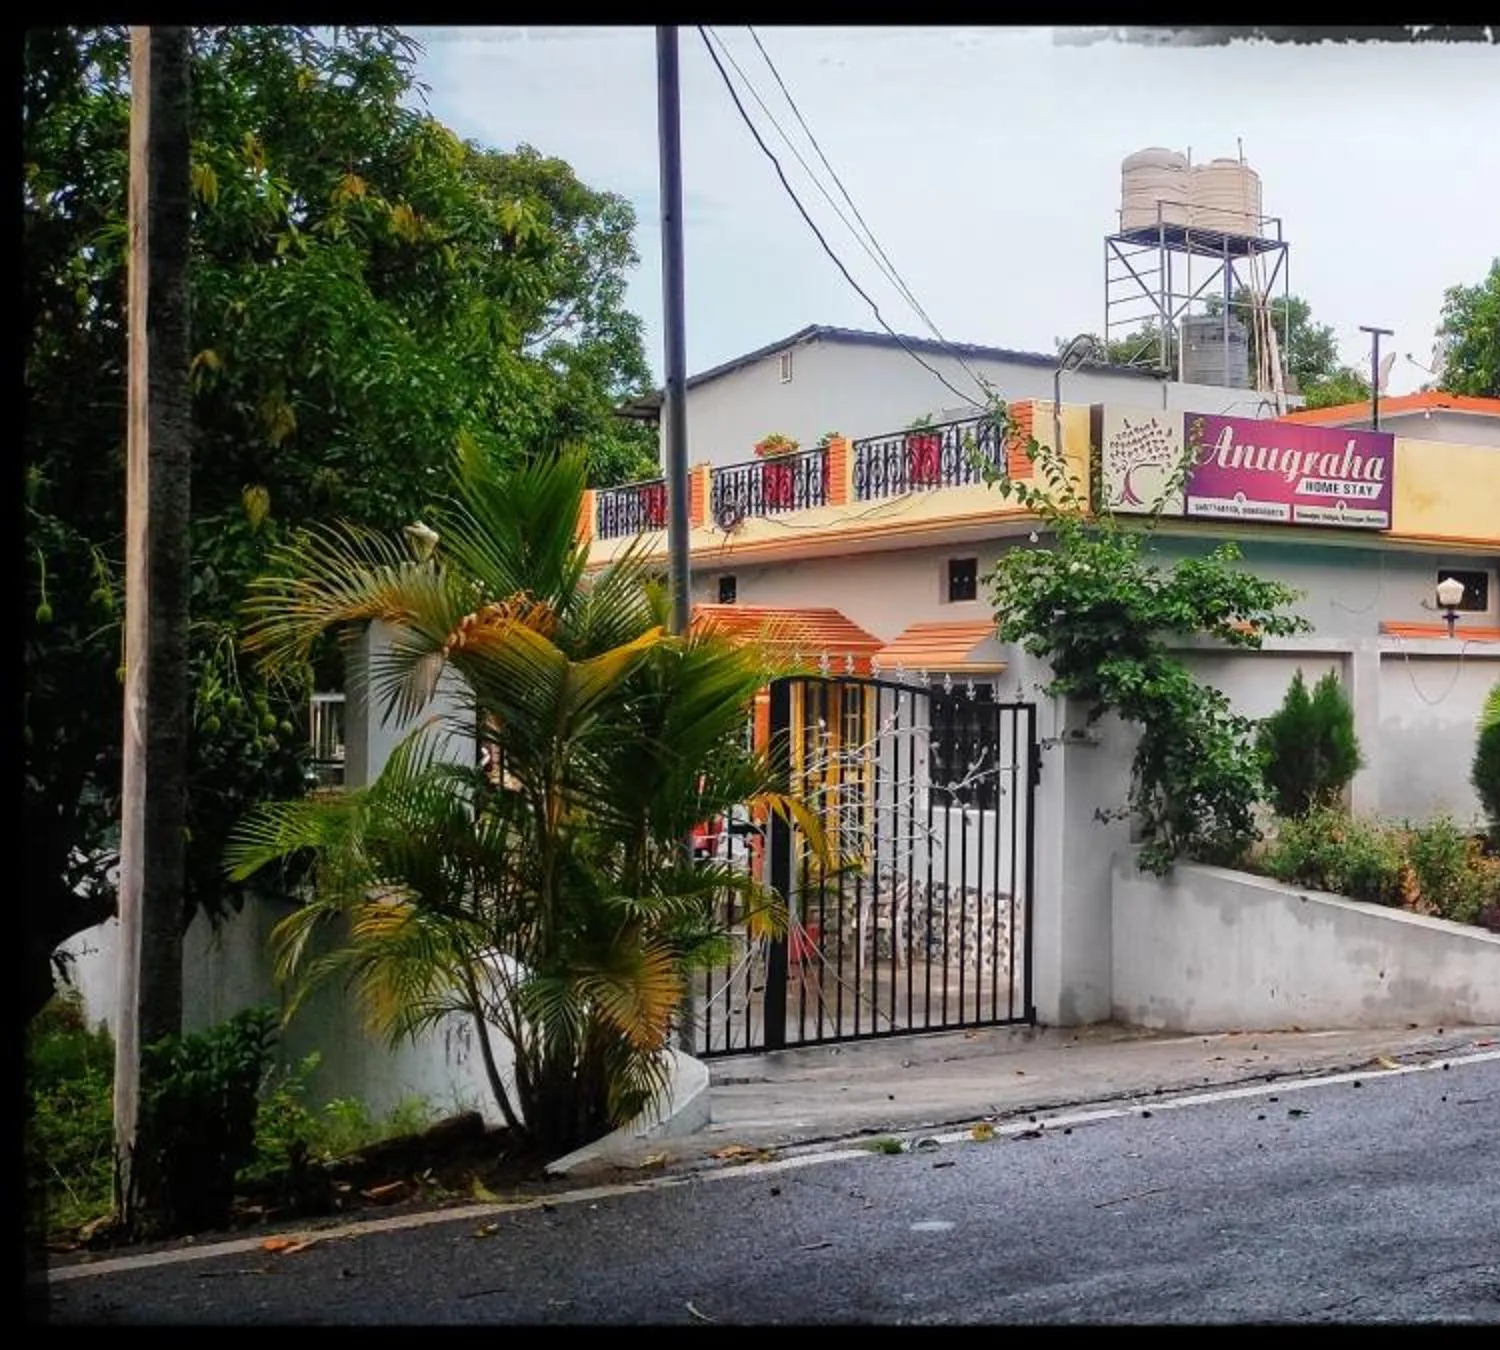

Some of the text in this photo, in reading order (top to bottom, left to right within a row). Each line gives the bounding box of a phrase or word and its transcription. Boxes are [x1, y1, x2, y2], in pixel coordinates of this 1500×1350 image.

[1193, 425, 1387, 483] Anugraha
[1304, 481, 1374, 497] HOME STAY
